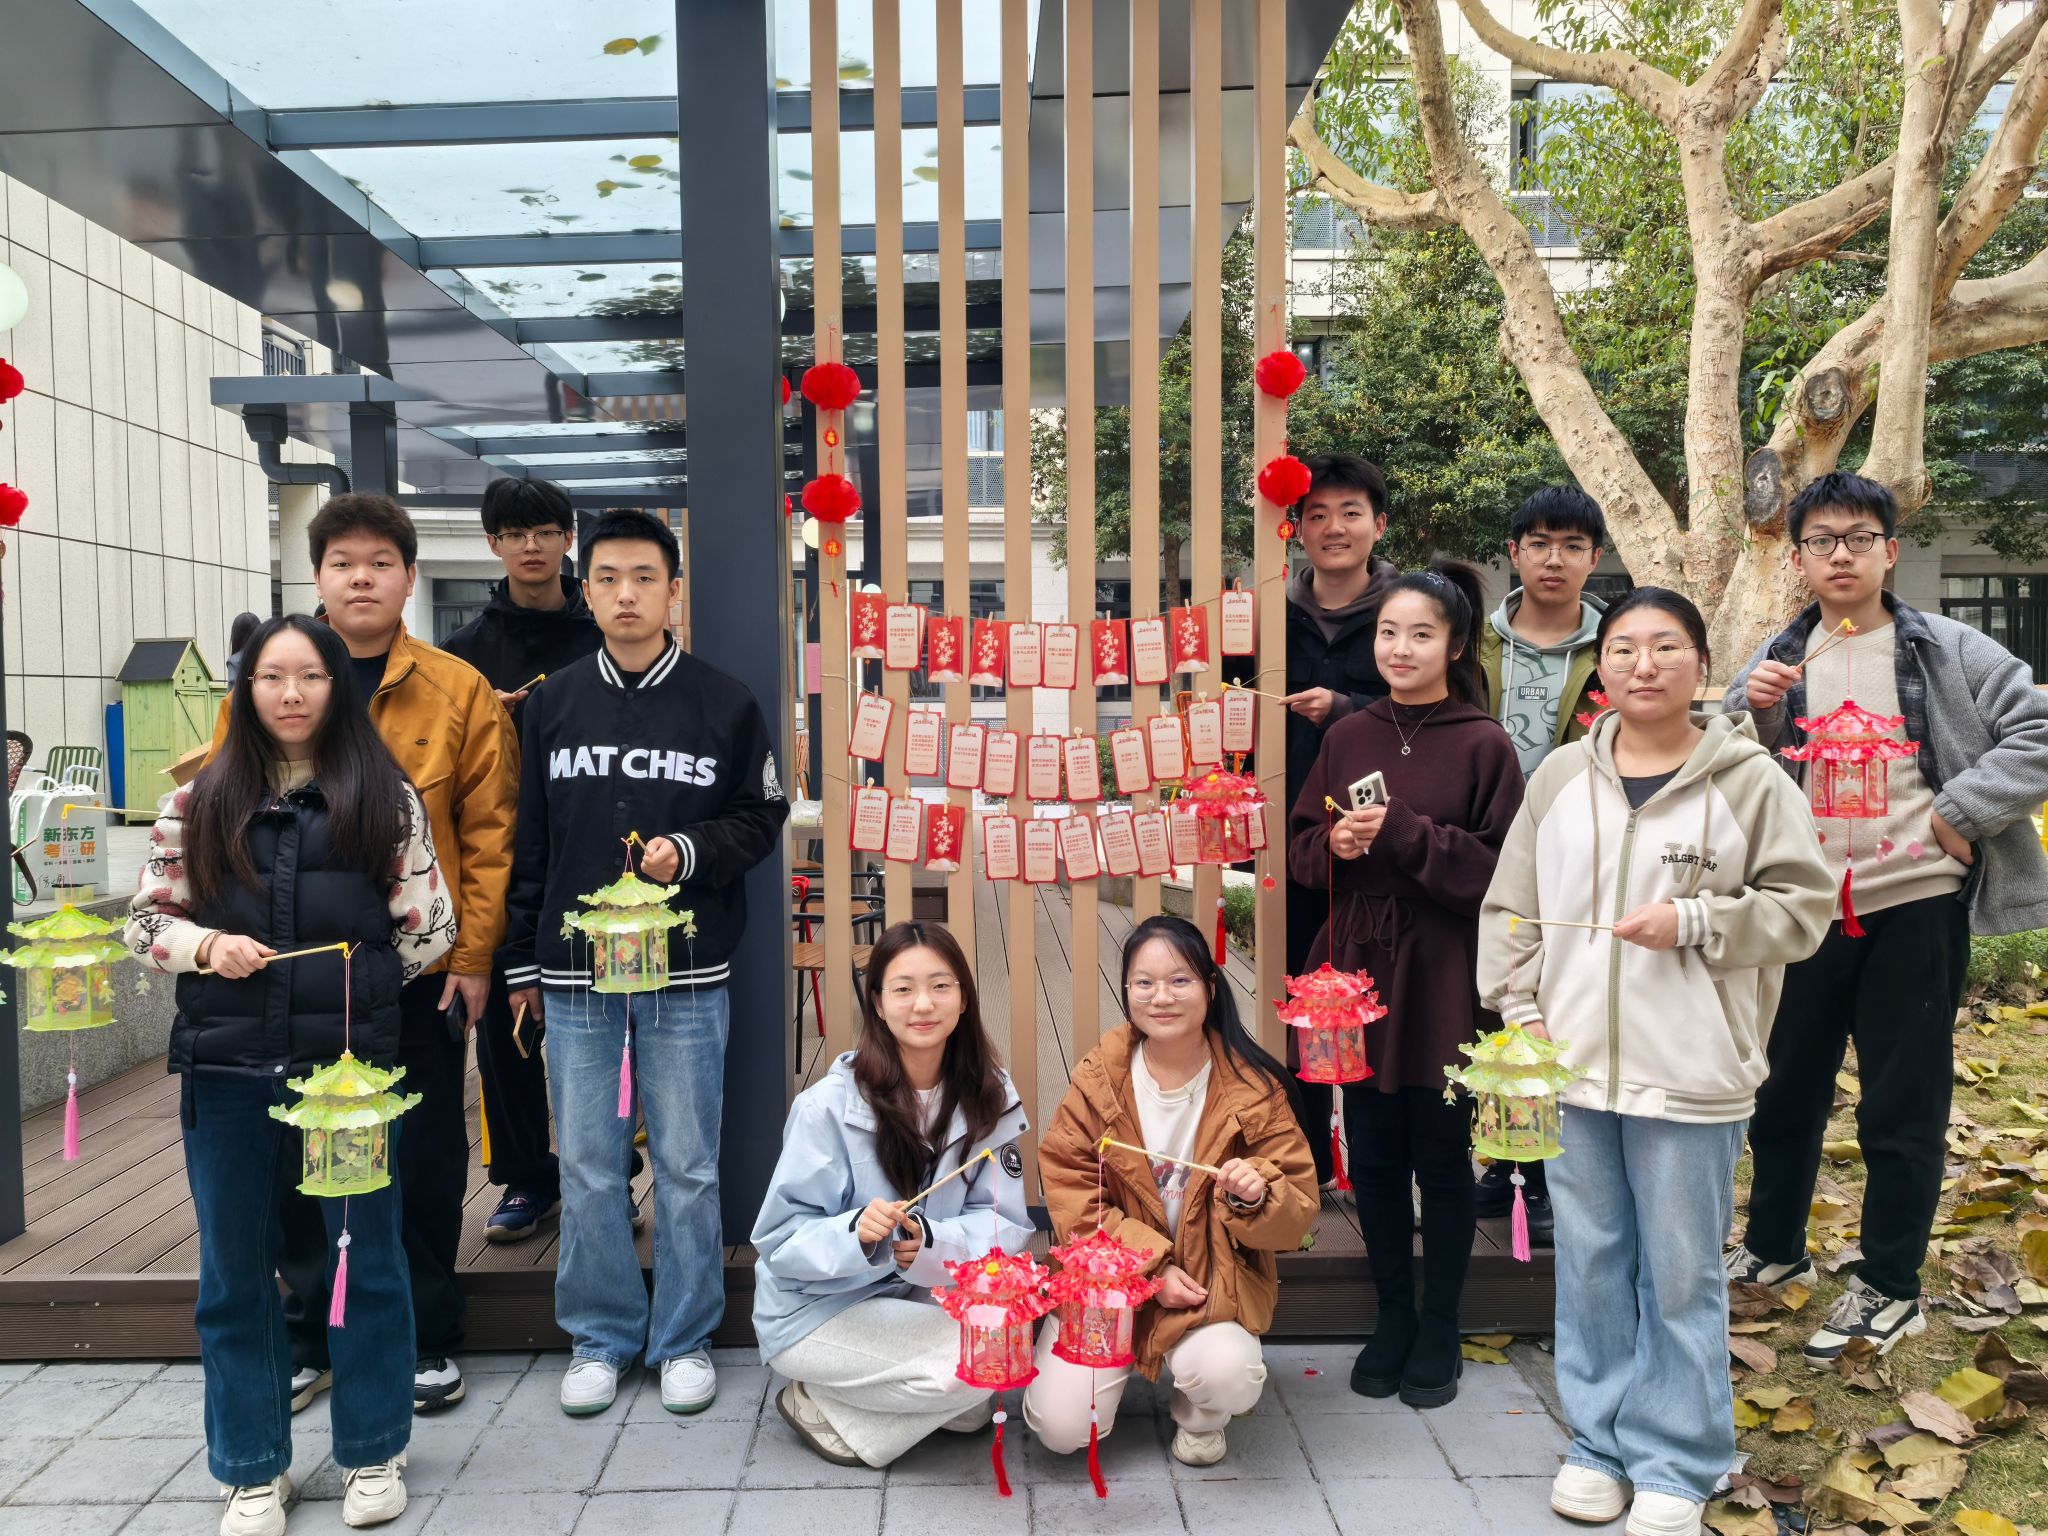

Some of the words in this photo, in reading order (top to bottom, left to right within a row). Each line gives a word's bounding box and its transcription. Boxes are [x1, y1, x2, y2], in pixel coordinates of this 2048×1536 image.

[1520, 687, 1546, 697] URBAN
[550, 746, 717, 787] MATCHES
[43, 826, 96, 842] 新东方
